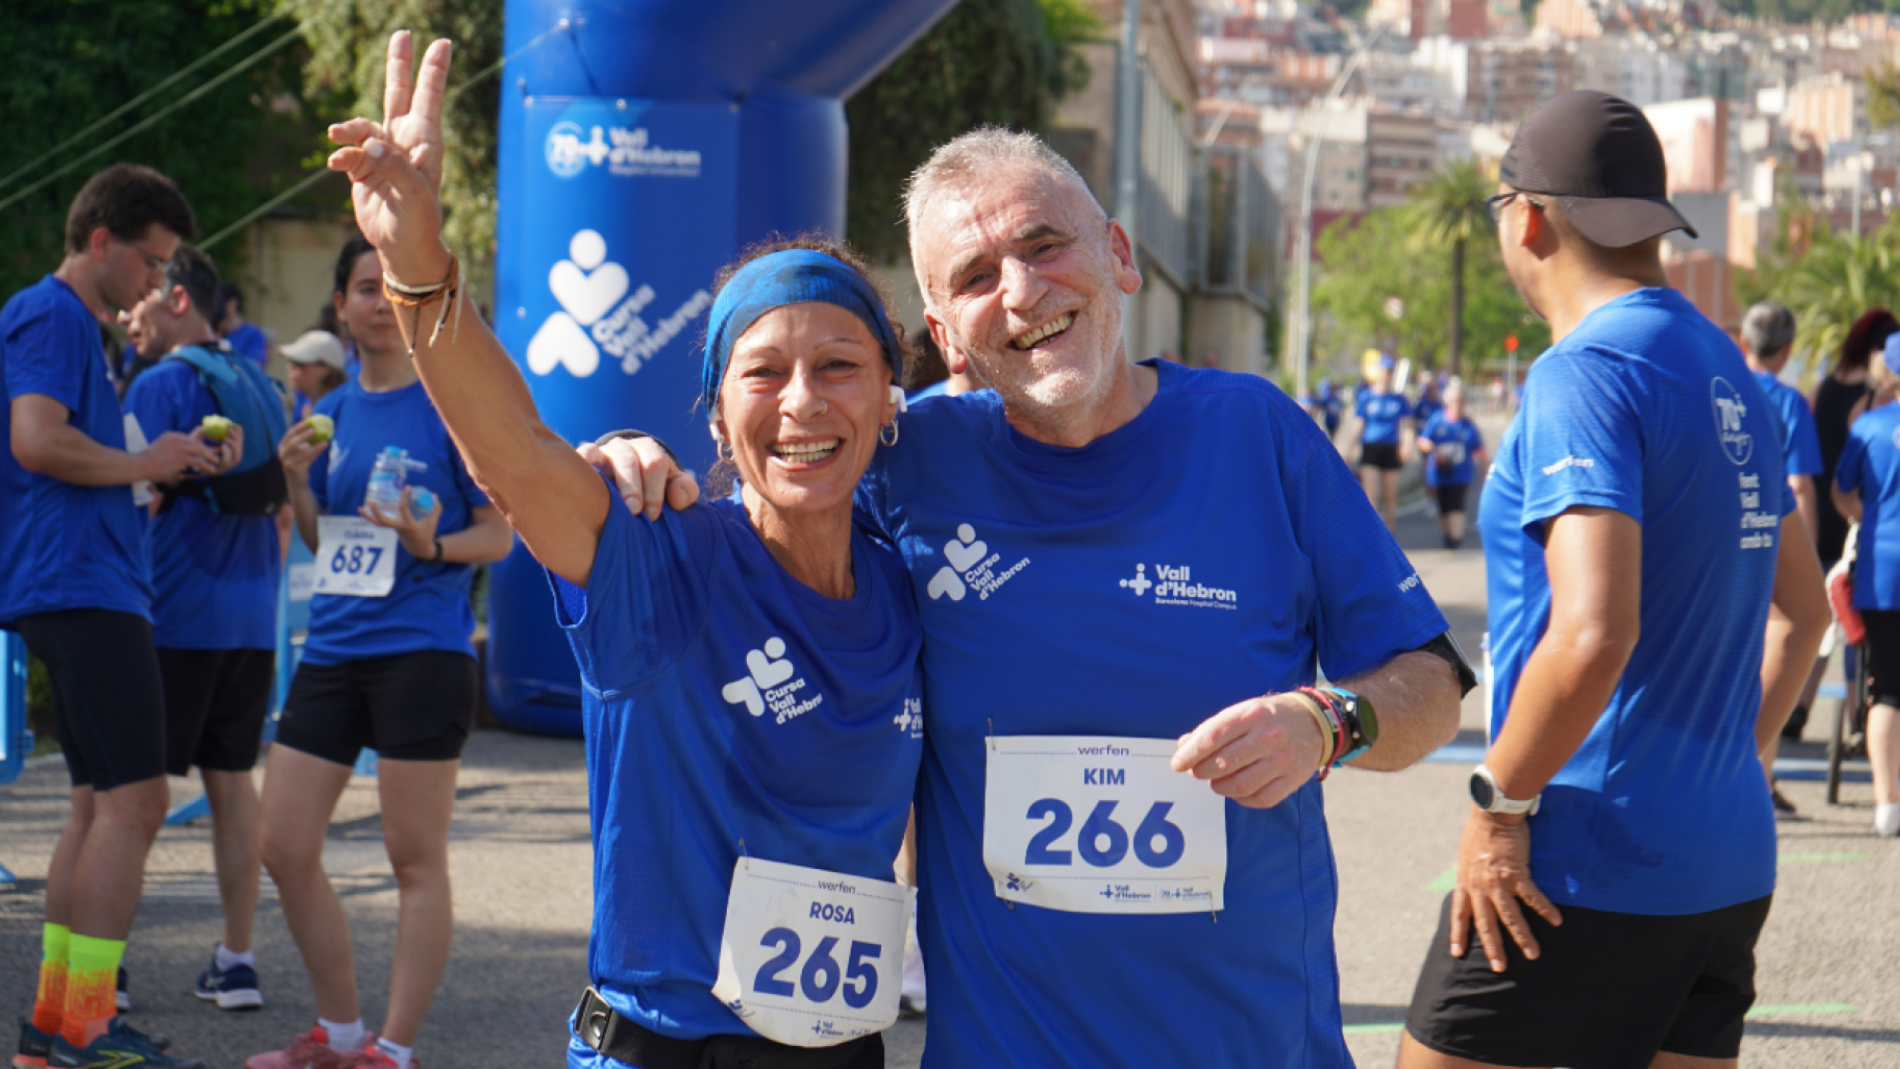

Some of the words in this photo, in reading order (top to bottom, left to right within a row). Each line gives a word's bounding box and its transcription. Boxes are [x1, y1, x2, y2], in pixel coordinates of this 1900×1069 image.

[609, 127, 648, 147] Vall
[609, 146, 701, 165] d'Hebron
[592, 284, 656, 343] Cursa
[603, 316, 649, 358] Vall
[621, 289, 712, 375] d'Hebron
[1740, 491, 1760, 509] Vall
[331, 544, 384, 575] 687
[965, 552, 1000, 583] Cursa
[970, 569, 995, 591] Vall
[980, 557, 1031, 600] d'Hebron
[1155, 564, 1190, 581] Vall
[1155, 581, 1237, 602] d'Hebron
[765, 678, 805, 702] Cursa
[769, 693, 796, 713] Vall
[1078, 744, 1129, 757] werfen
[1083, 768, 1126, 785] KIM
[1025, 797, 1186, 869] 266
[817, 880, 856, 895] werfen
[809, 901, 855, 925] ROSA
[753, 927, 882, 1010] 265
